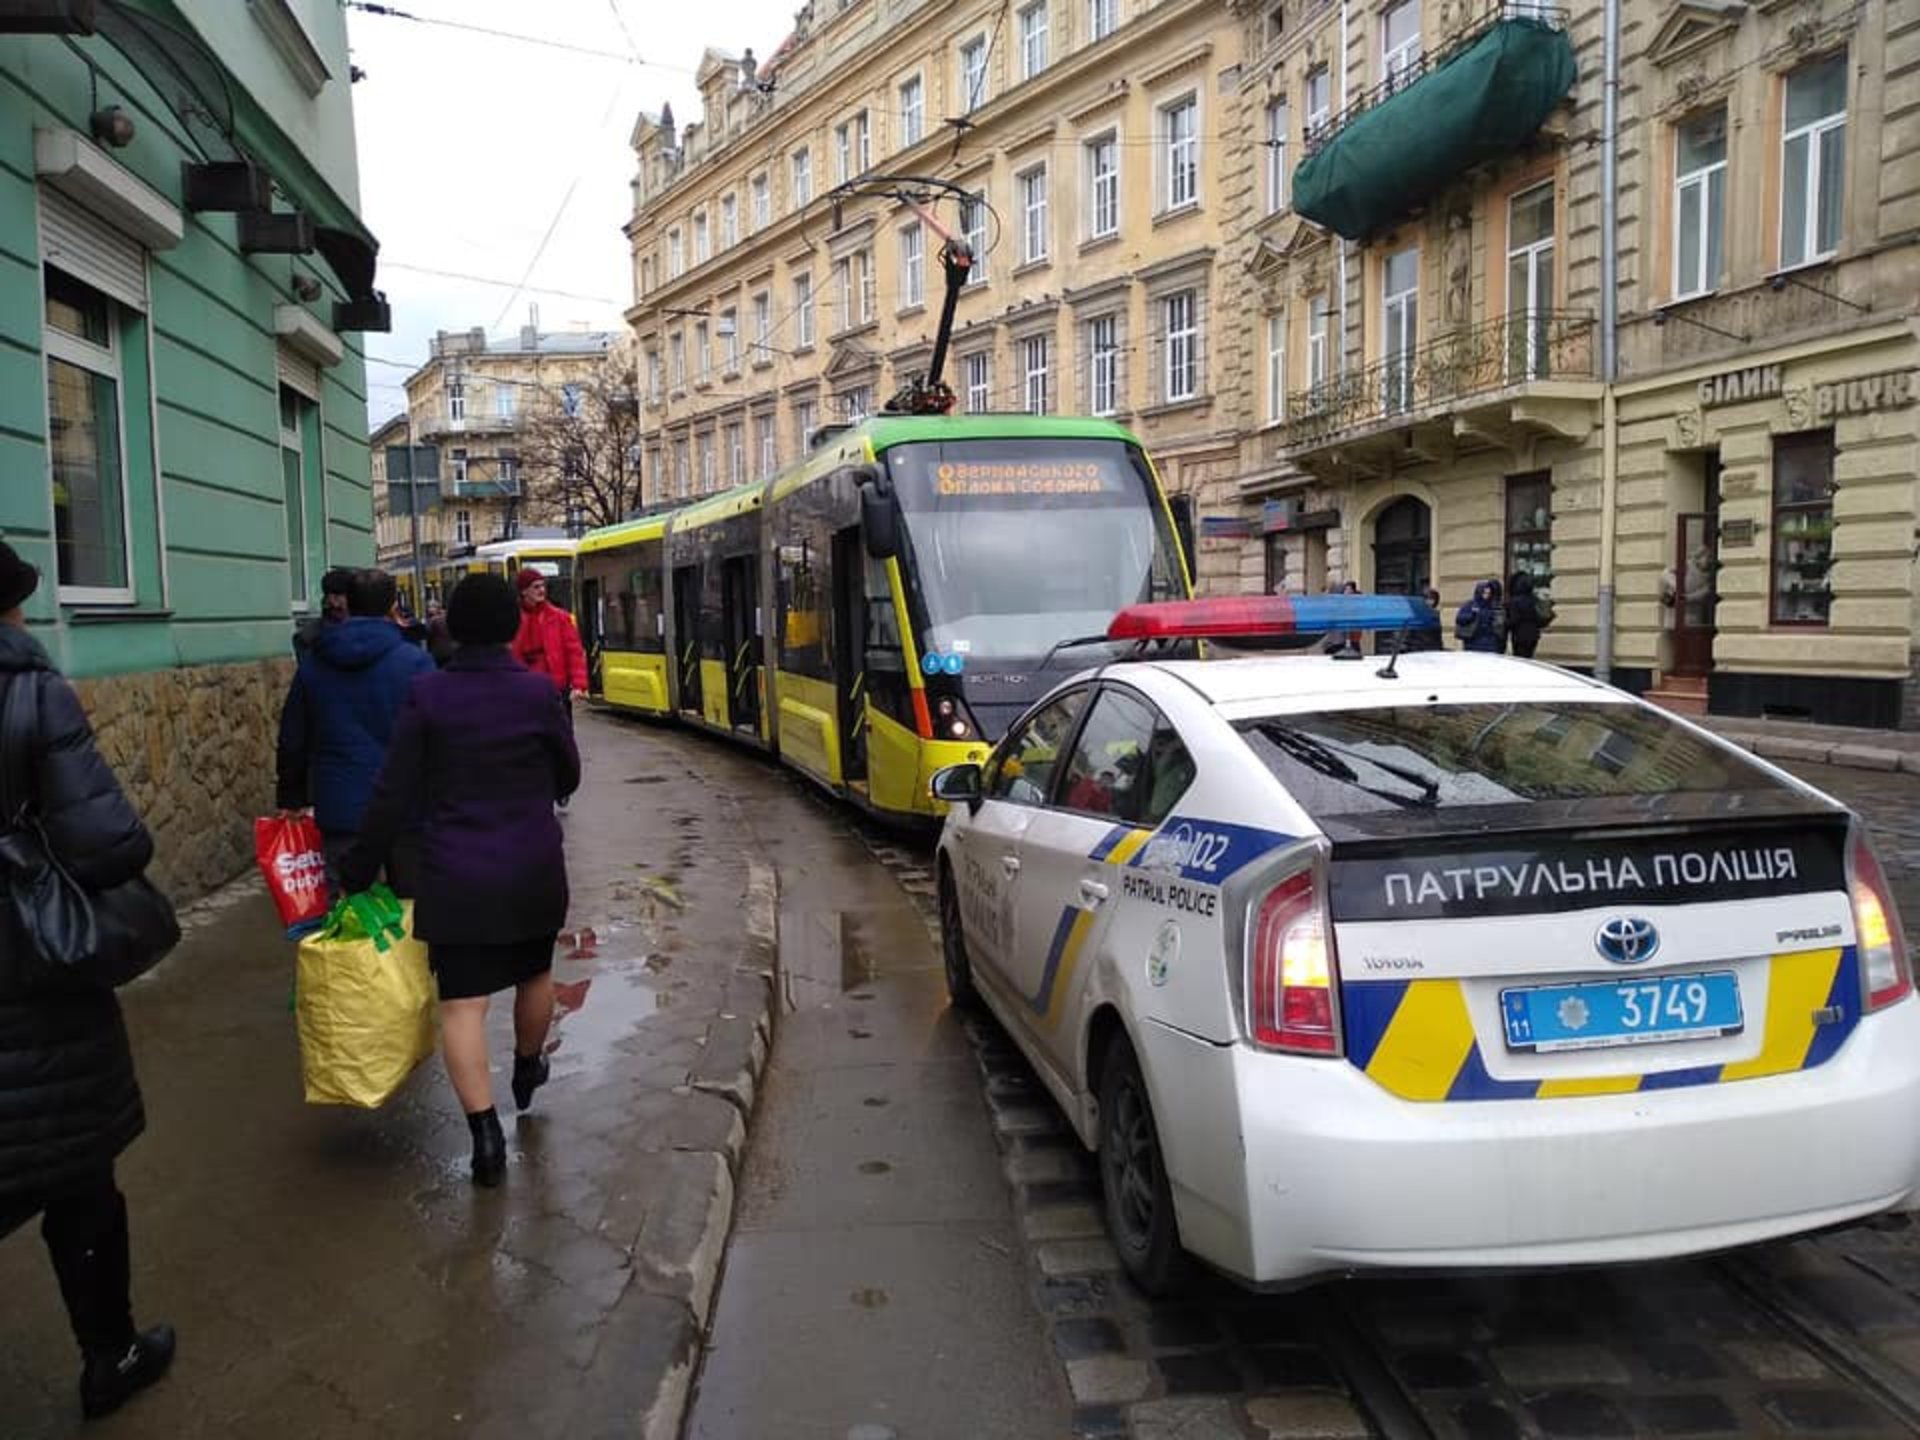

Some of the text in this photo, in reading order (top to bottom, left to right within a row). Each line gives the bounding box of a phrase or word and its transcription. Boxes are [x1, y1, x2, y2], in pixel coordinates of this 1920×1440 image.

[1697, 364, 1781, 404] БІЛИК
[1815, 373, 1910, 416] BILYK
[1186, 831, 1229, 872] 102
[1385, 848, 1798, 905] ПАТРУЛЬНА ПОЛІЦІЯ
[1167, 885, 1217, 917] POLICE
[1617, 982, 1708, 1029] 3749
[1511, 1019, 1532, 1038] 11
